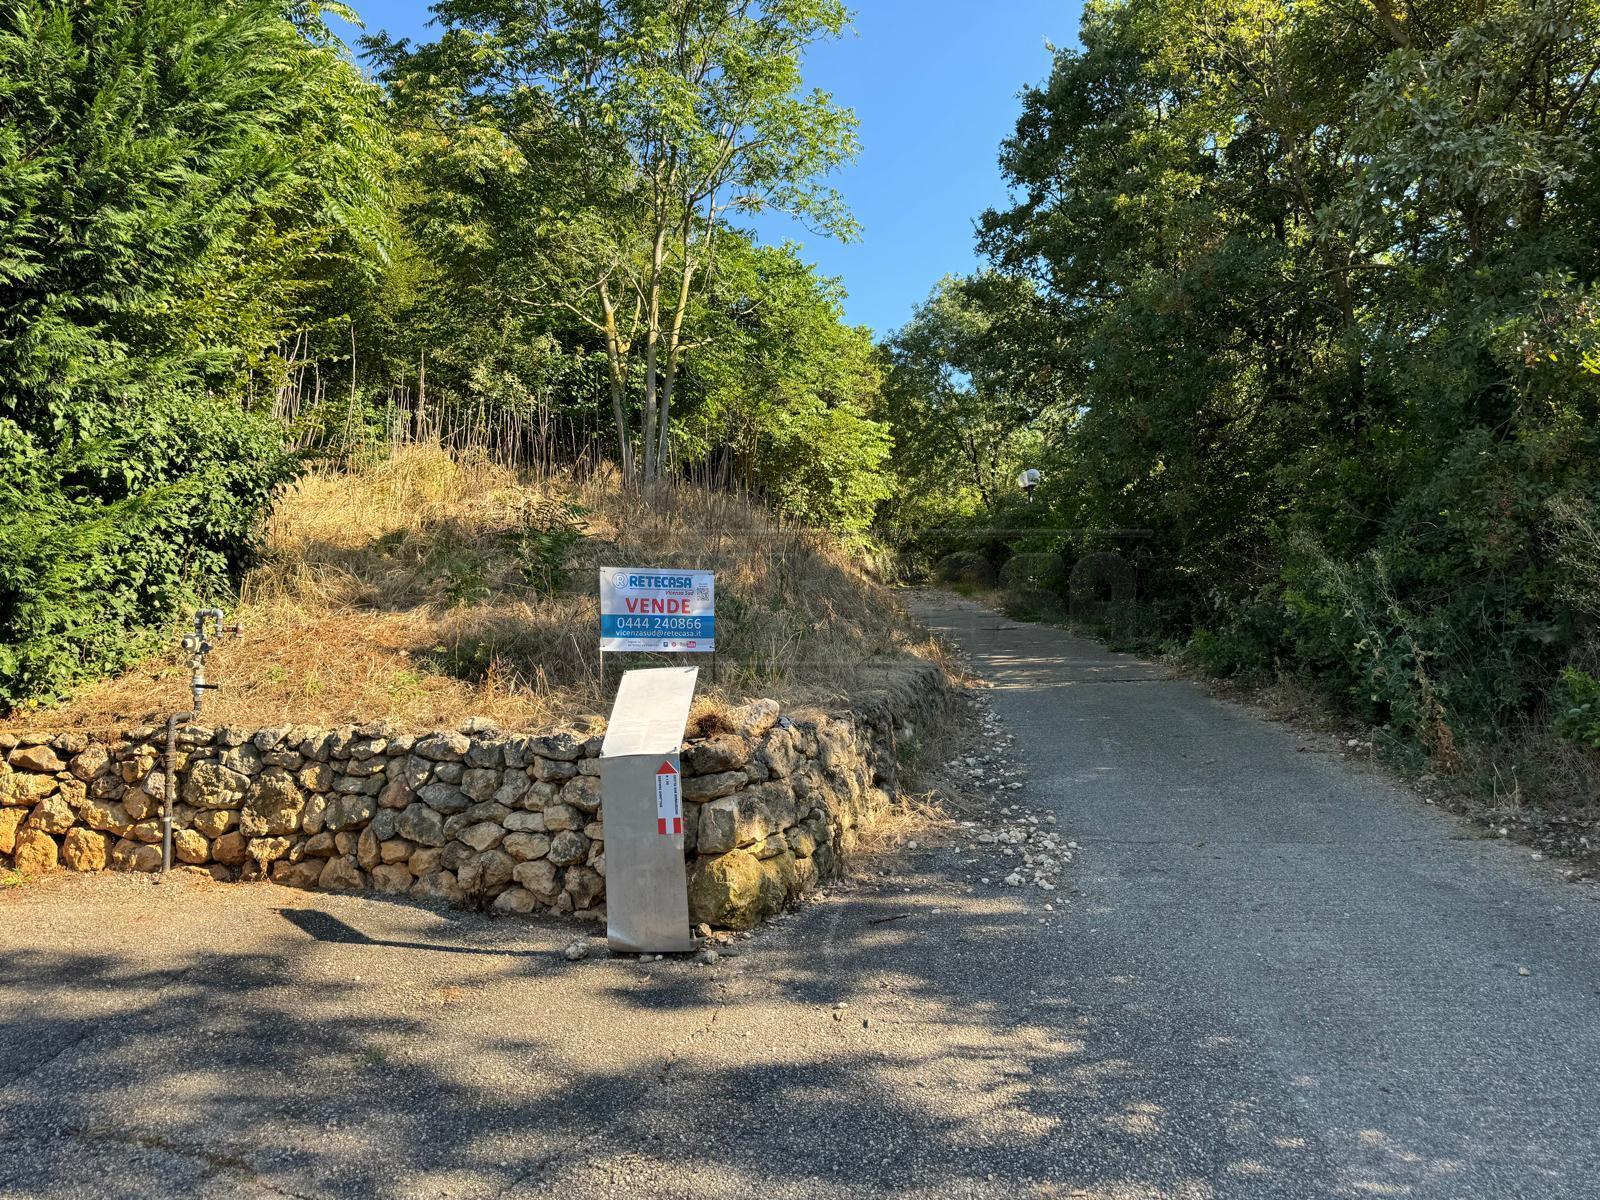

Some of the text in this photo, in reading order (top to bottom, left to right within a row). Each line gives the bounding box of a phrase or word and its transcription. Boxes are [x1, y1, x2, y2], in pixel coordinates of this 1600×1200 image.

[629, 575, 692, 588] RETECASA
[625, 597, 691, 614] VENDE
[616, 617, 702, 629] 0444 240866
[615, 630, 702, 638] vicenzasud@retecasa.it
